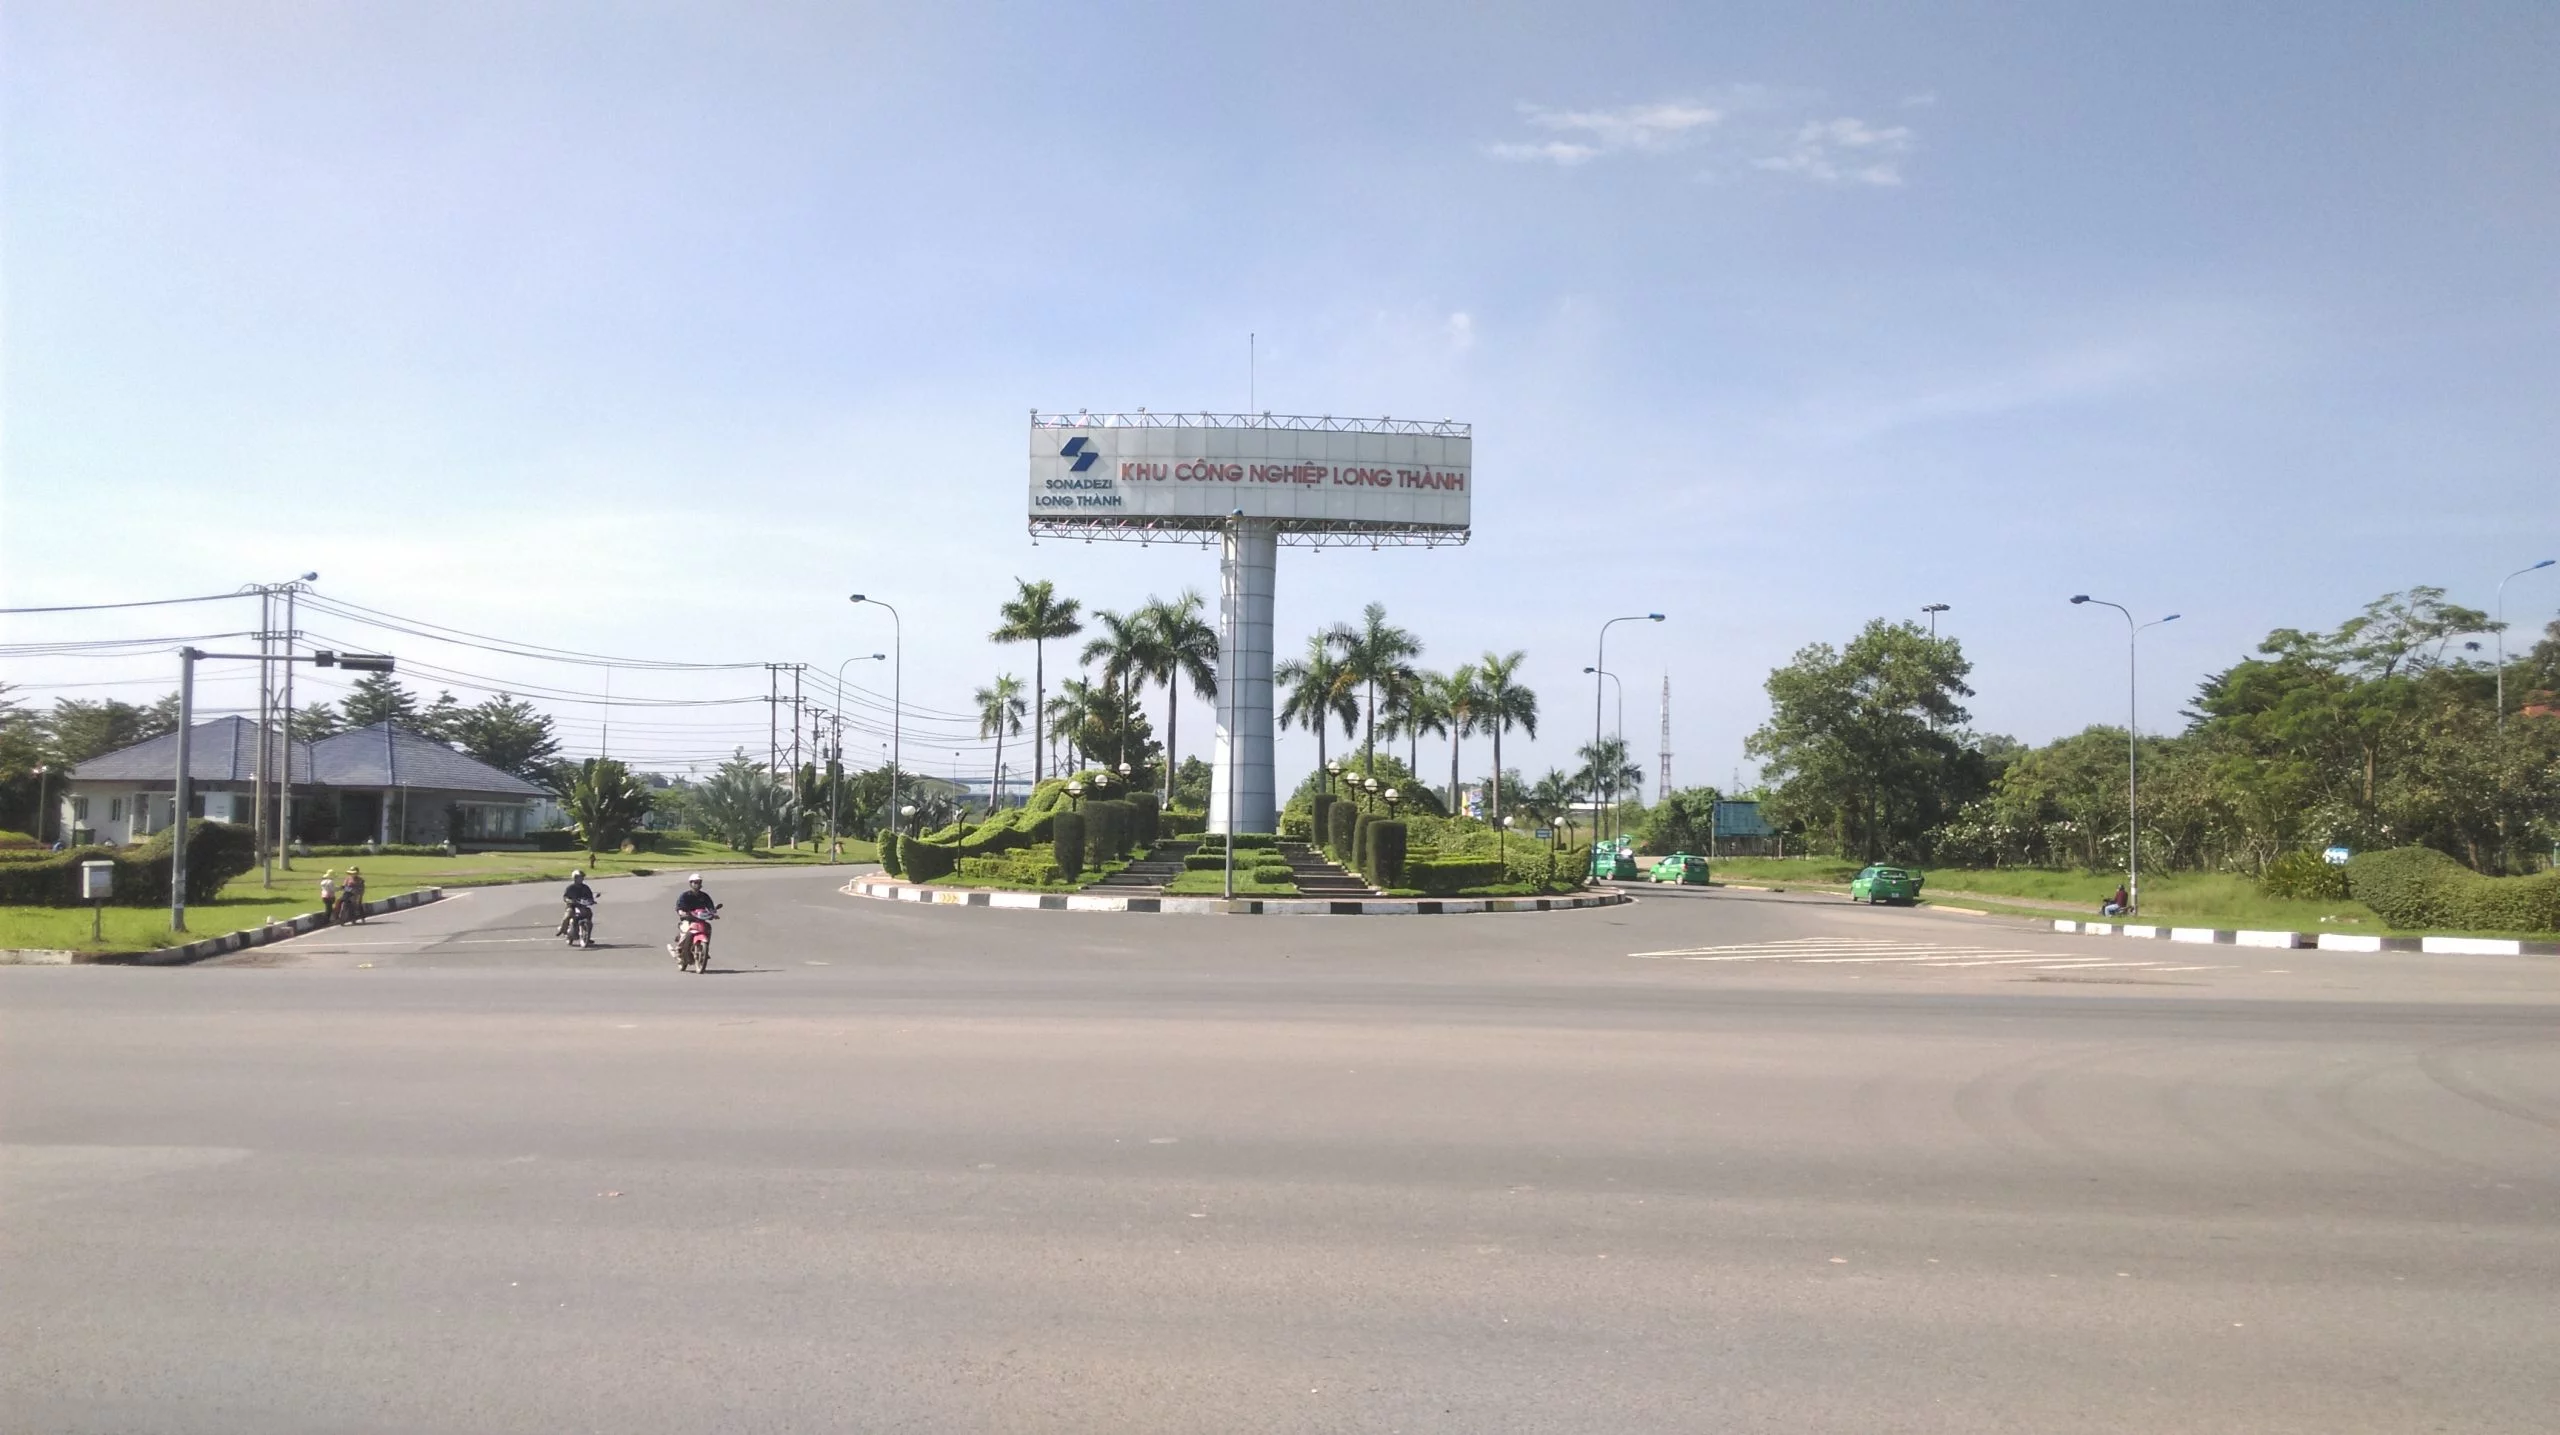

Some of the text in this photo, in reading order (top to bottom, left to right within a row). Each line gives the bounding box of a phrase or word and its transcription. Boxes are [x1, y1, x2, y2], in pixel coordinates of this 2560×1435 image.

[1121, 458, 1464, 491] KHU CÔNG NGHIỆP LONG THÀNH
[1046, 479, 1113, 490] SONADEZI
[1035, 493, 1122, 506] LONG THÀNH
